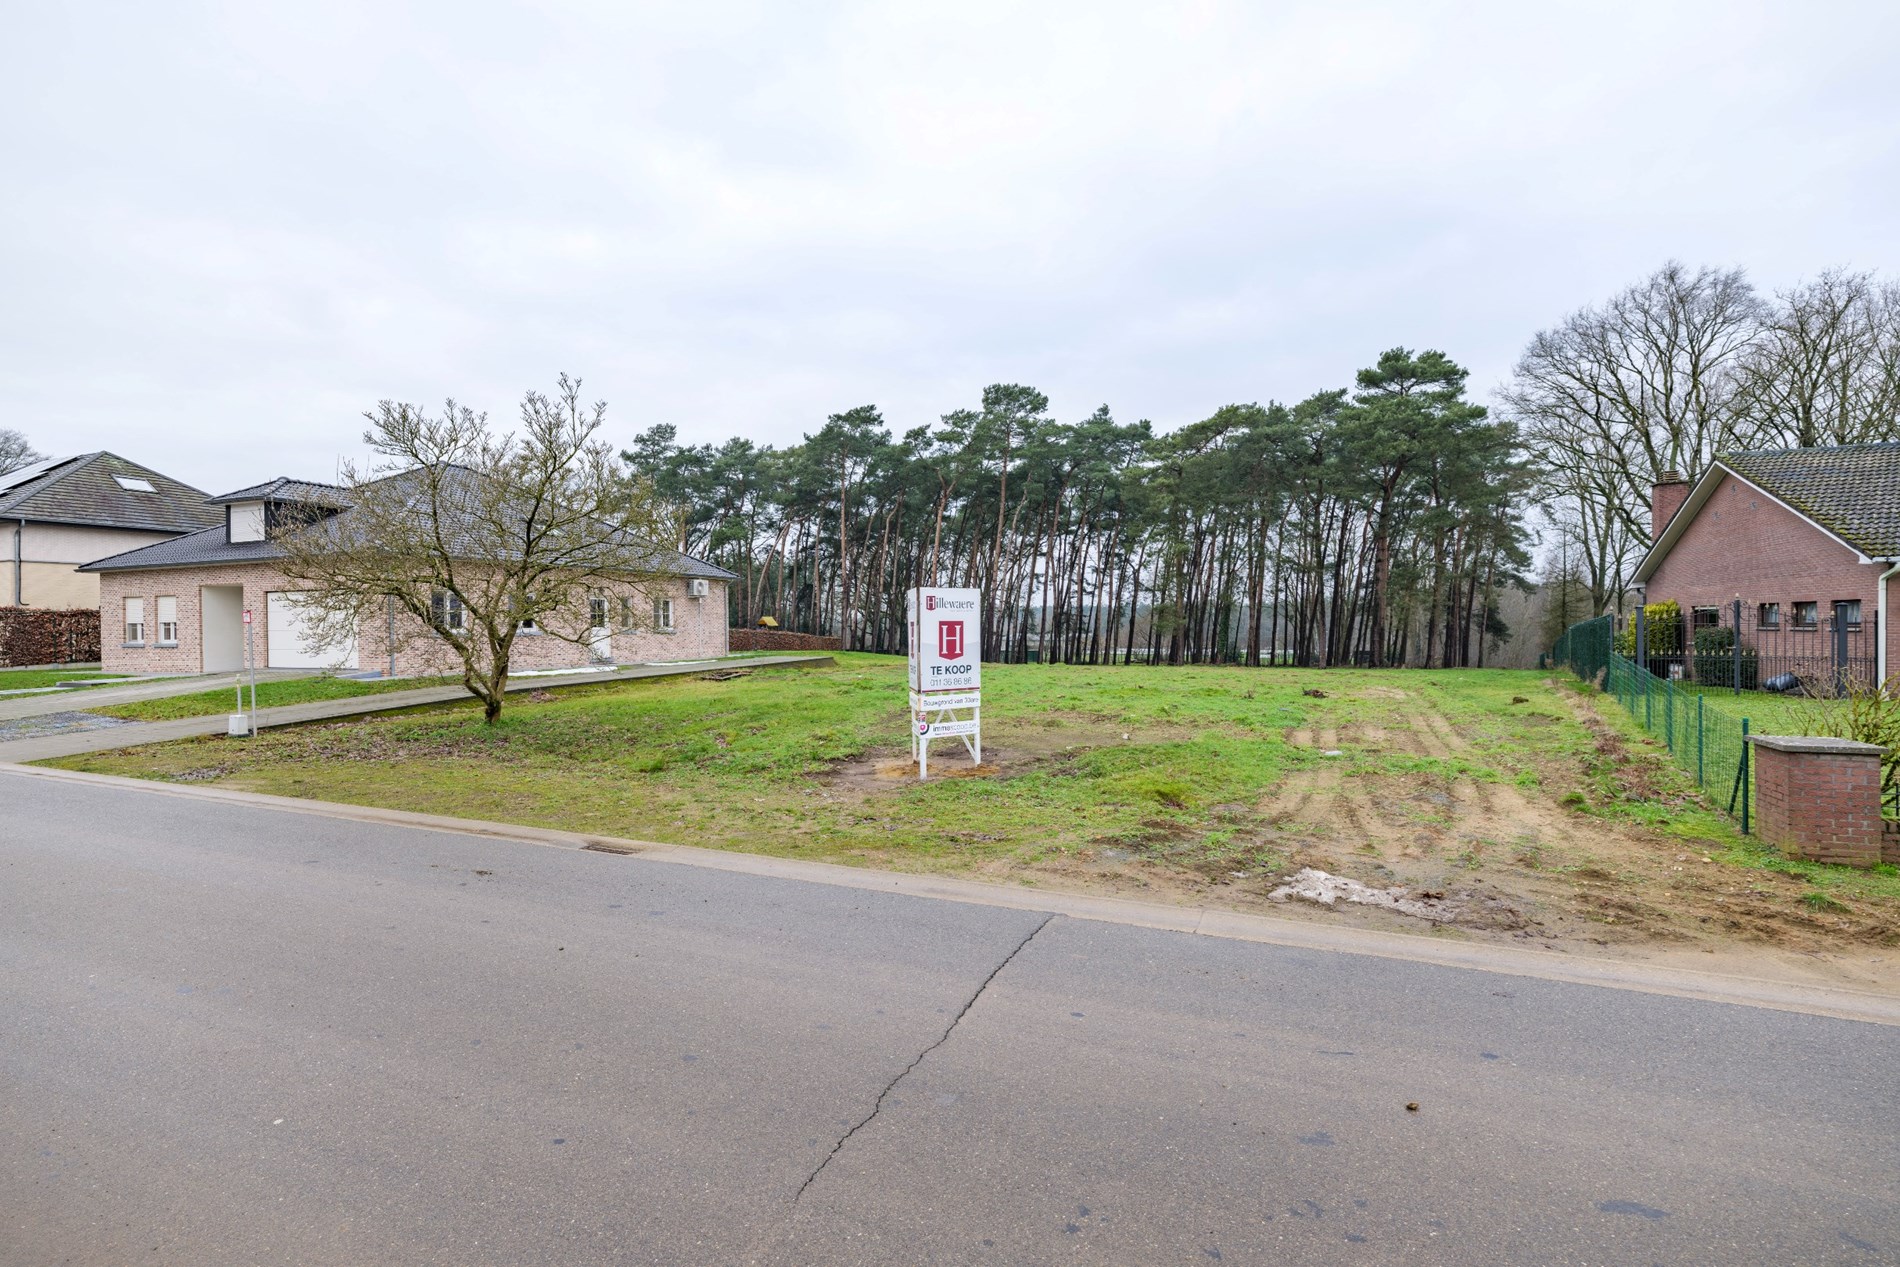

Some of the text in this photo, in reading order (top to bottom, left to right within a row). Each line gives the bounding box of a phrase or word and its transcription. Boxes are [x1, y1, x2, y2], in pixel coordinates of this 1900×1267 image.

[927, 596, 975, 610] Hillewaere
[930, 665, 943, 676] TE
[945, 664, 972, 675] KOOP
[930, 679, 942, 687] 011
[943, 678, 953, 686] 36
[953, 677, 963, 686] 86
[923, 699, 953, 707] Bouwgrond
